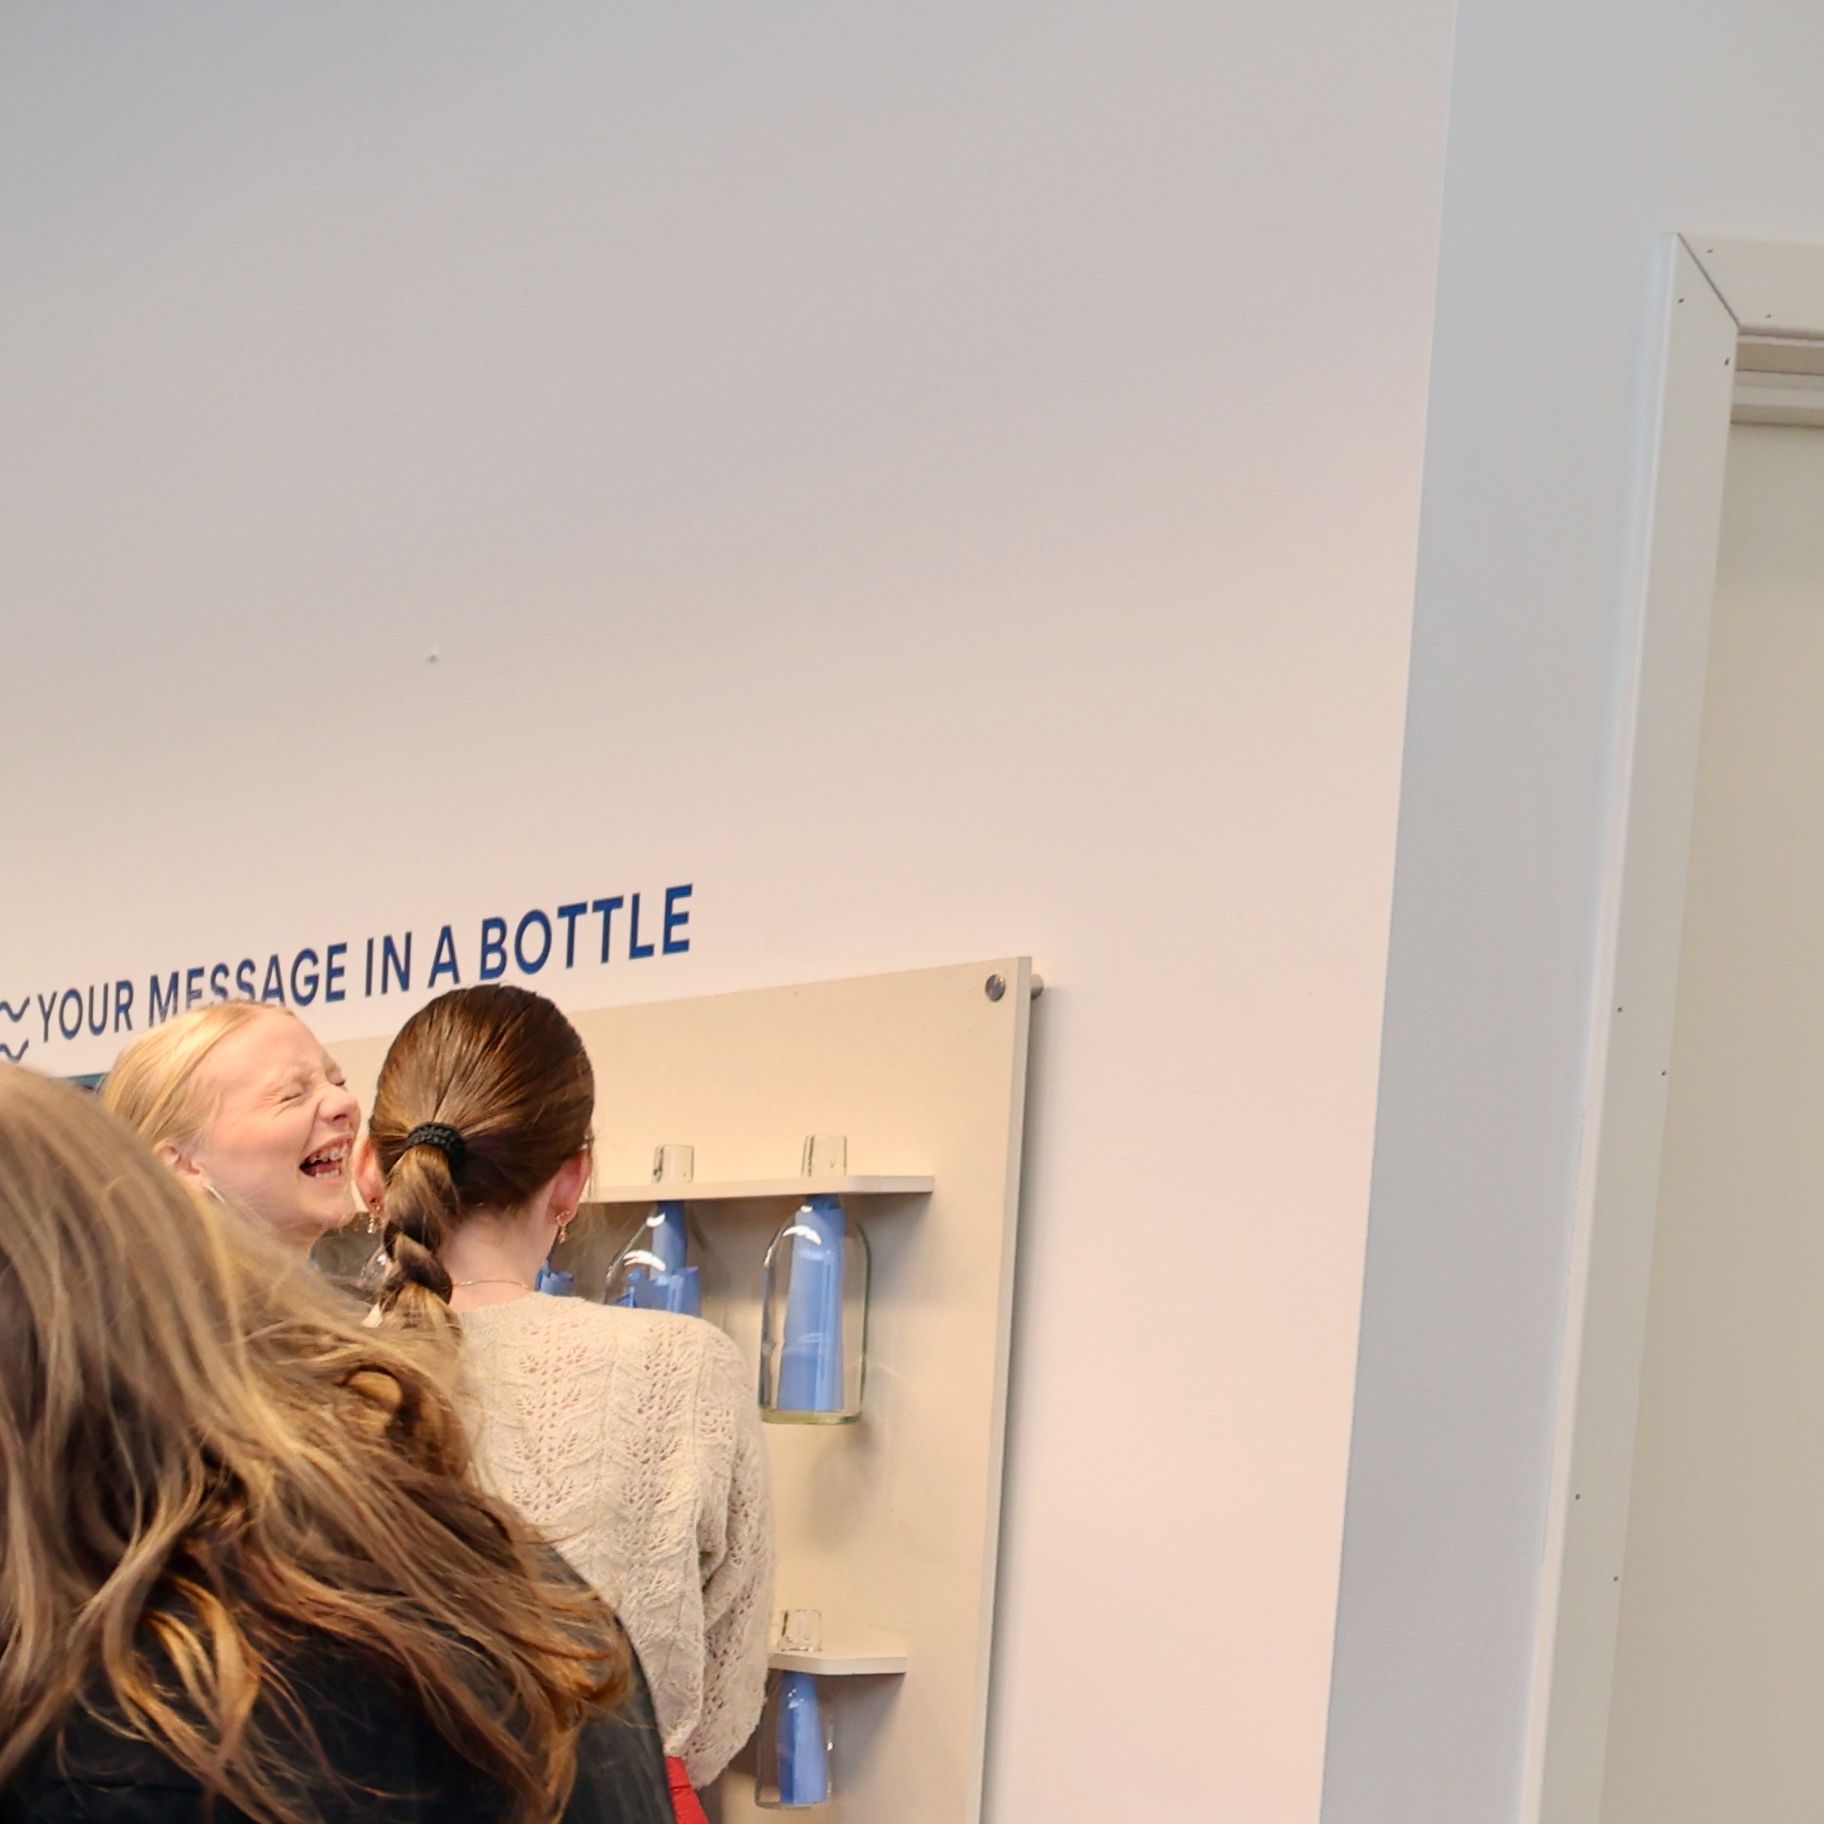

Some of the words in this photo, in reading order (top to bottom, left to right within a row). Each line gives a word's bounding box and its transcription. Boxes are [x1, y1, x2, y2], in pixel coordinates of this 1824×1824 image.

[37, 978, 134, 1043] YOUR
[148, 942, 348, 1027] MESSAGE
[365, 931, 412, 997] IN
[428, 925, 461, 989] A
[479, 883, 694, 981] BOTTLE
